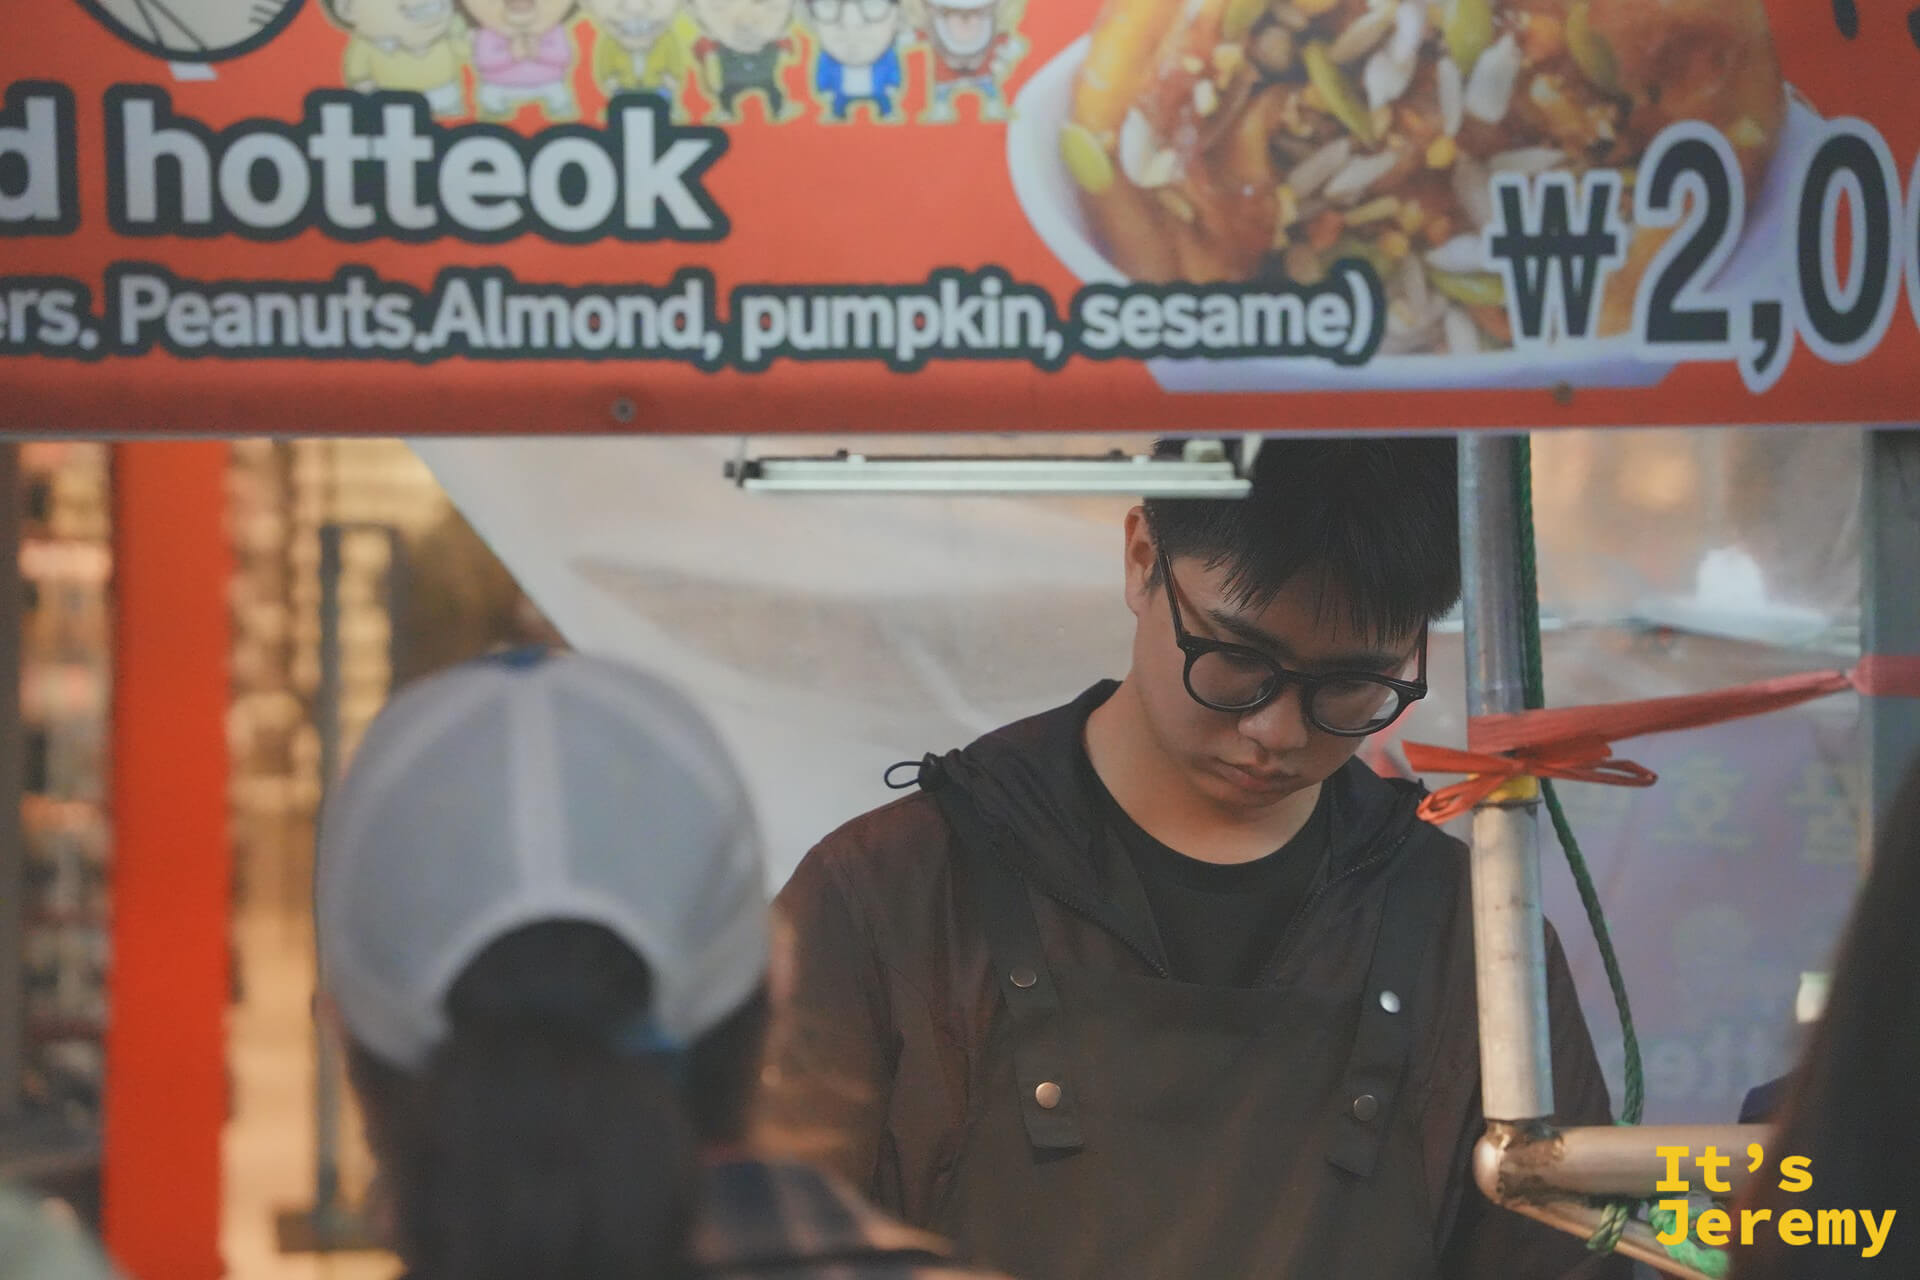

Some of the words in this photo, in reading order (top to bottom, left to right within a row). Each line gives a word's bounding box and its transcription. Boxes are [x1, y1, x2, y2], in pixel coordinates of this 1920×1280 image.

[122, 97, 714, 231] hotteok
[0, 286, 99, 350] rs.
[741, 278, 1063, 361] pumpkin,
[1079, 269, 1375, 356] sesame)
[1490, 130, 1920, 376] ₩2,0
